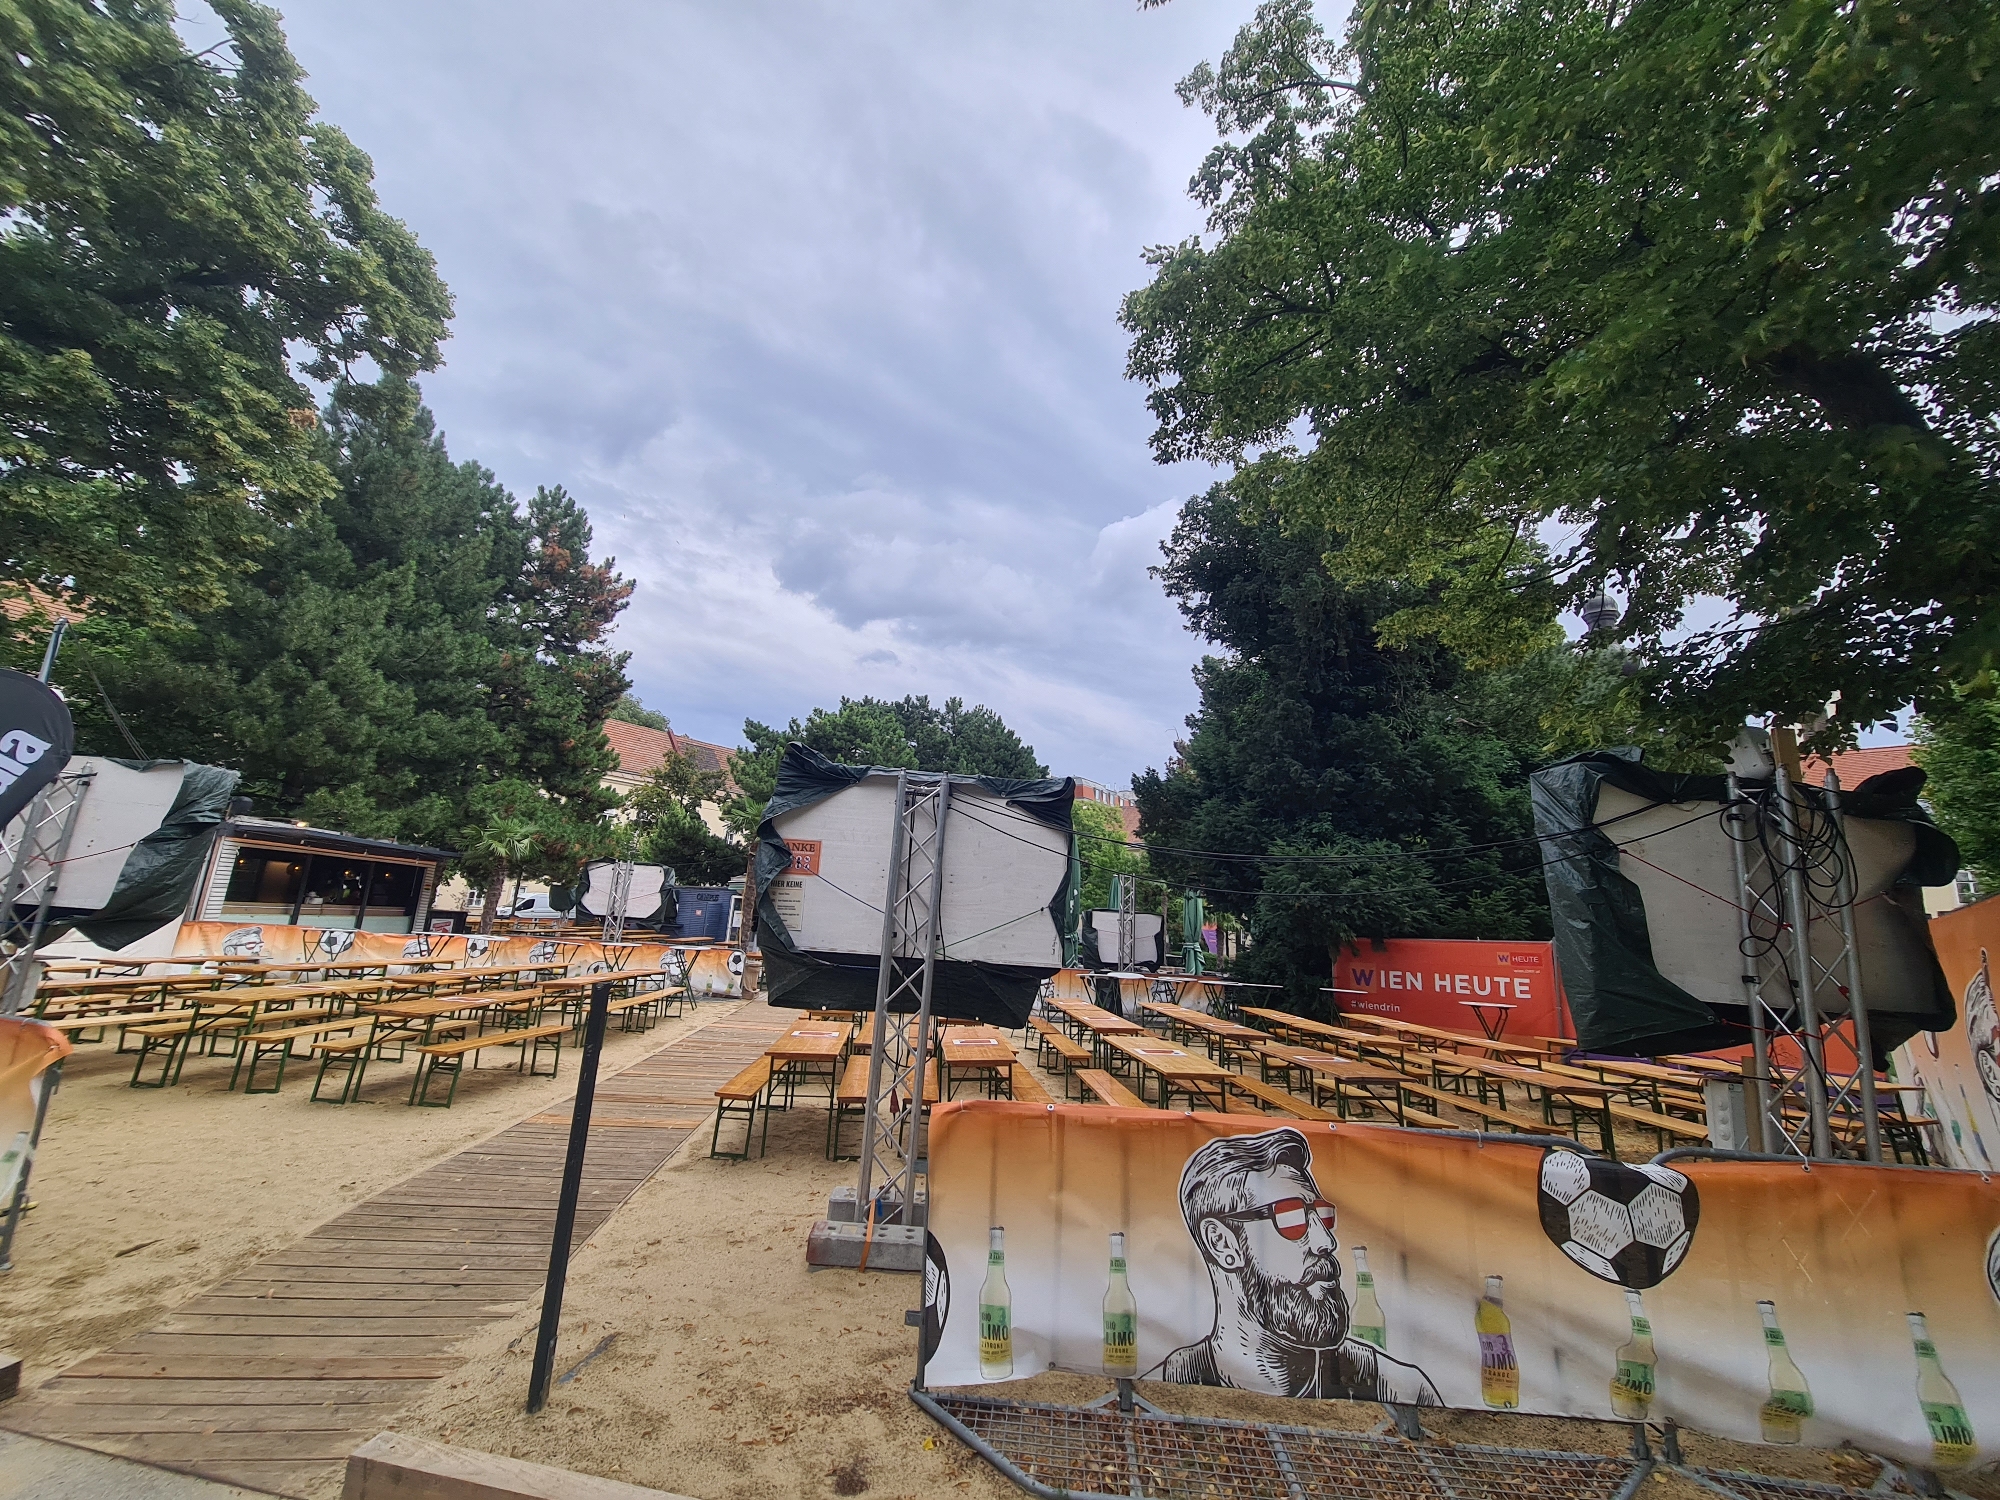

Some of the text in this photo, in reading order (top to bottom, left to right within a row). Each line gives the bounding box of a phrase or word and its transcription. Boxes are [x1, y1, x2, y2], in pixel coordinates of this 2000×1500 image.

[785, 842, 815, 852] ANKE
[770, 880, 785, 888] HIER
[1498, 955, 1509, 963] W
[1351, 968, 1532, 999] WIEN HEUTE
[1350, 1000, 1401, 1013] #wiendrin
[982, 1323, 1009, 1341] LIMO
[1105, 1331, 1135, 1347] LIMO
[1484, 1353, 1516, 1370] LIMO
[1930, 1424, 1972, 1446] LIMO
